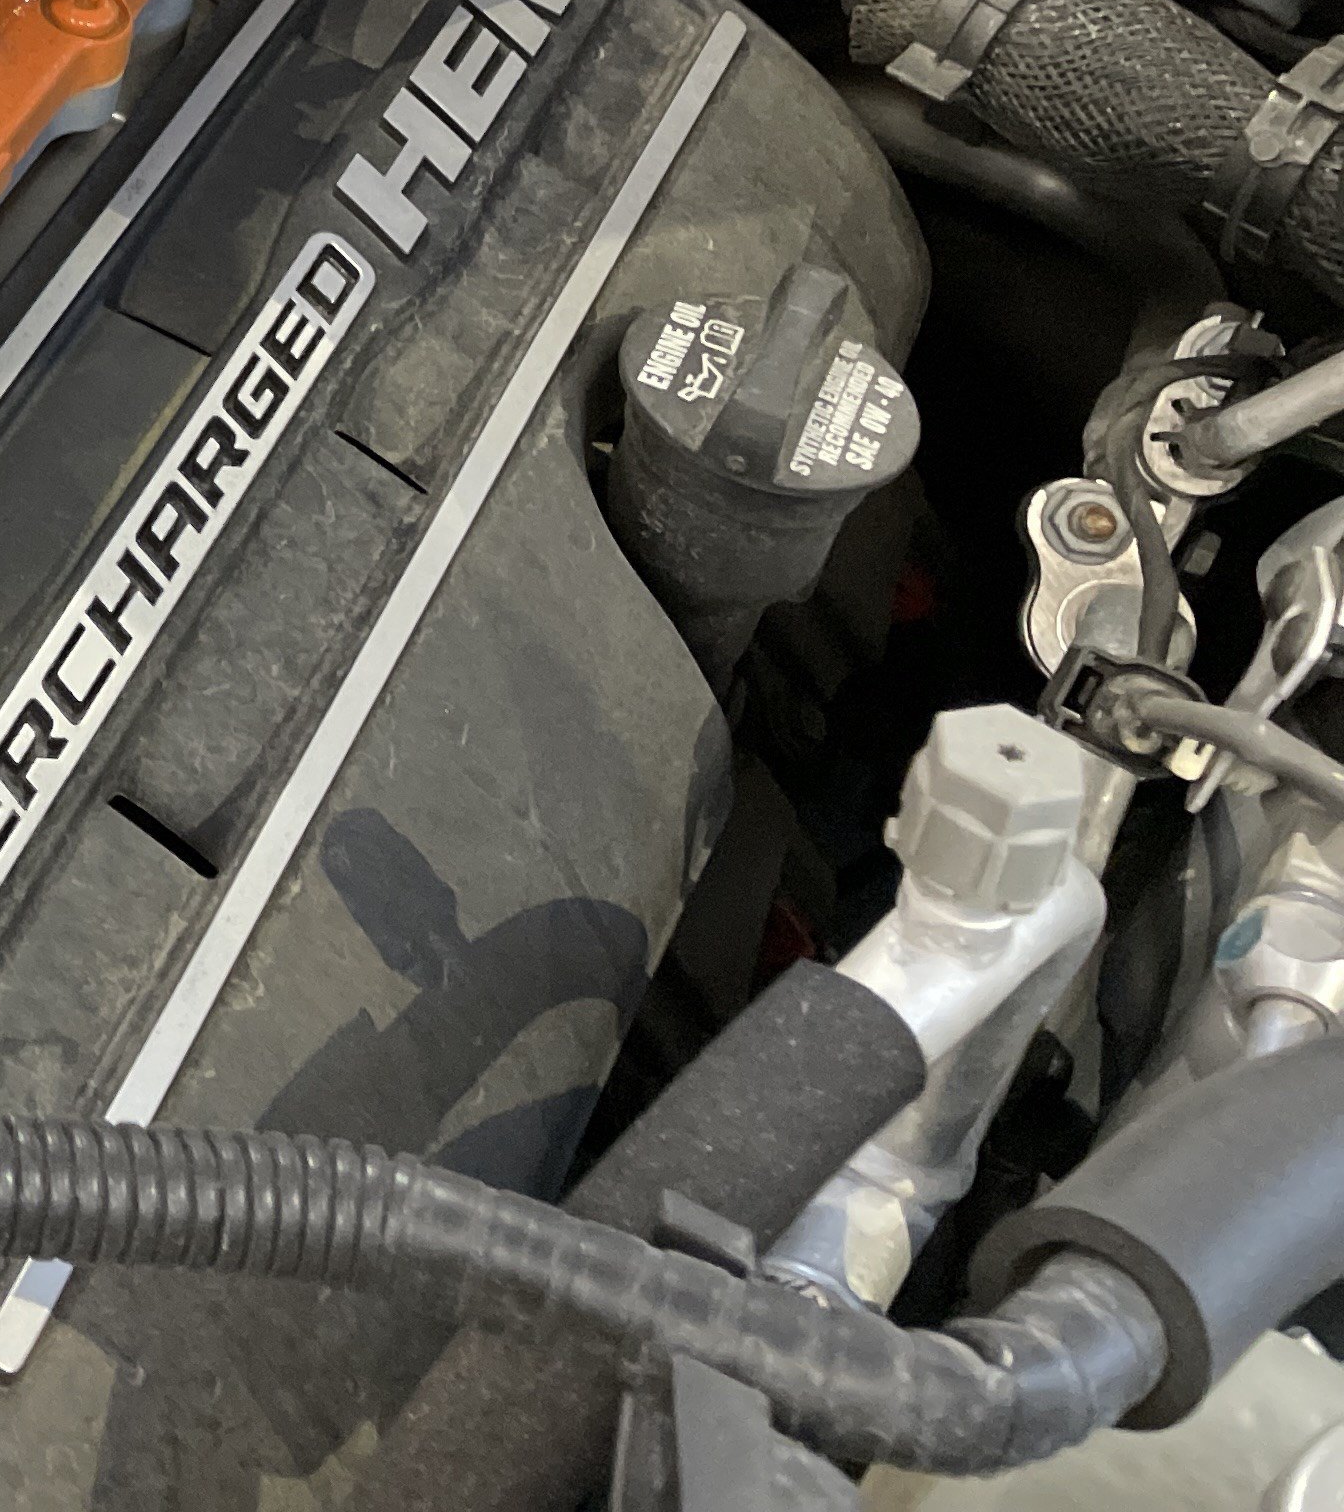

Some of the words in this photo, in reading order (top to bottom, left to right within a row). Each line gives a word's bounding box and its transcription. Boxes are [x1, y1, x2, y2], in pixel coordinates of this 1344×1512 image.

[637, 323, 696, 390] ENGINE
[669, 301, 707, 328] OIL
[789, 400, 834, 477] SYNTHETIC
[818, 356, 854, 405] ENGINE
[838, 340, 863, 360] OIL
[818, 360, 875, 467] RECOMMENDED
[845, 431, 881, 471] SAE
